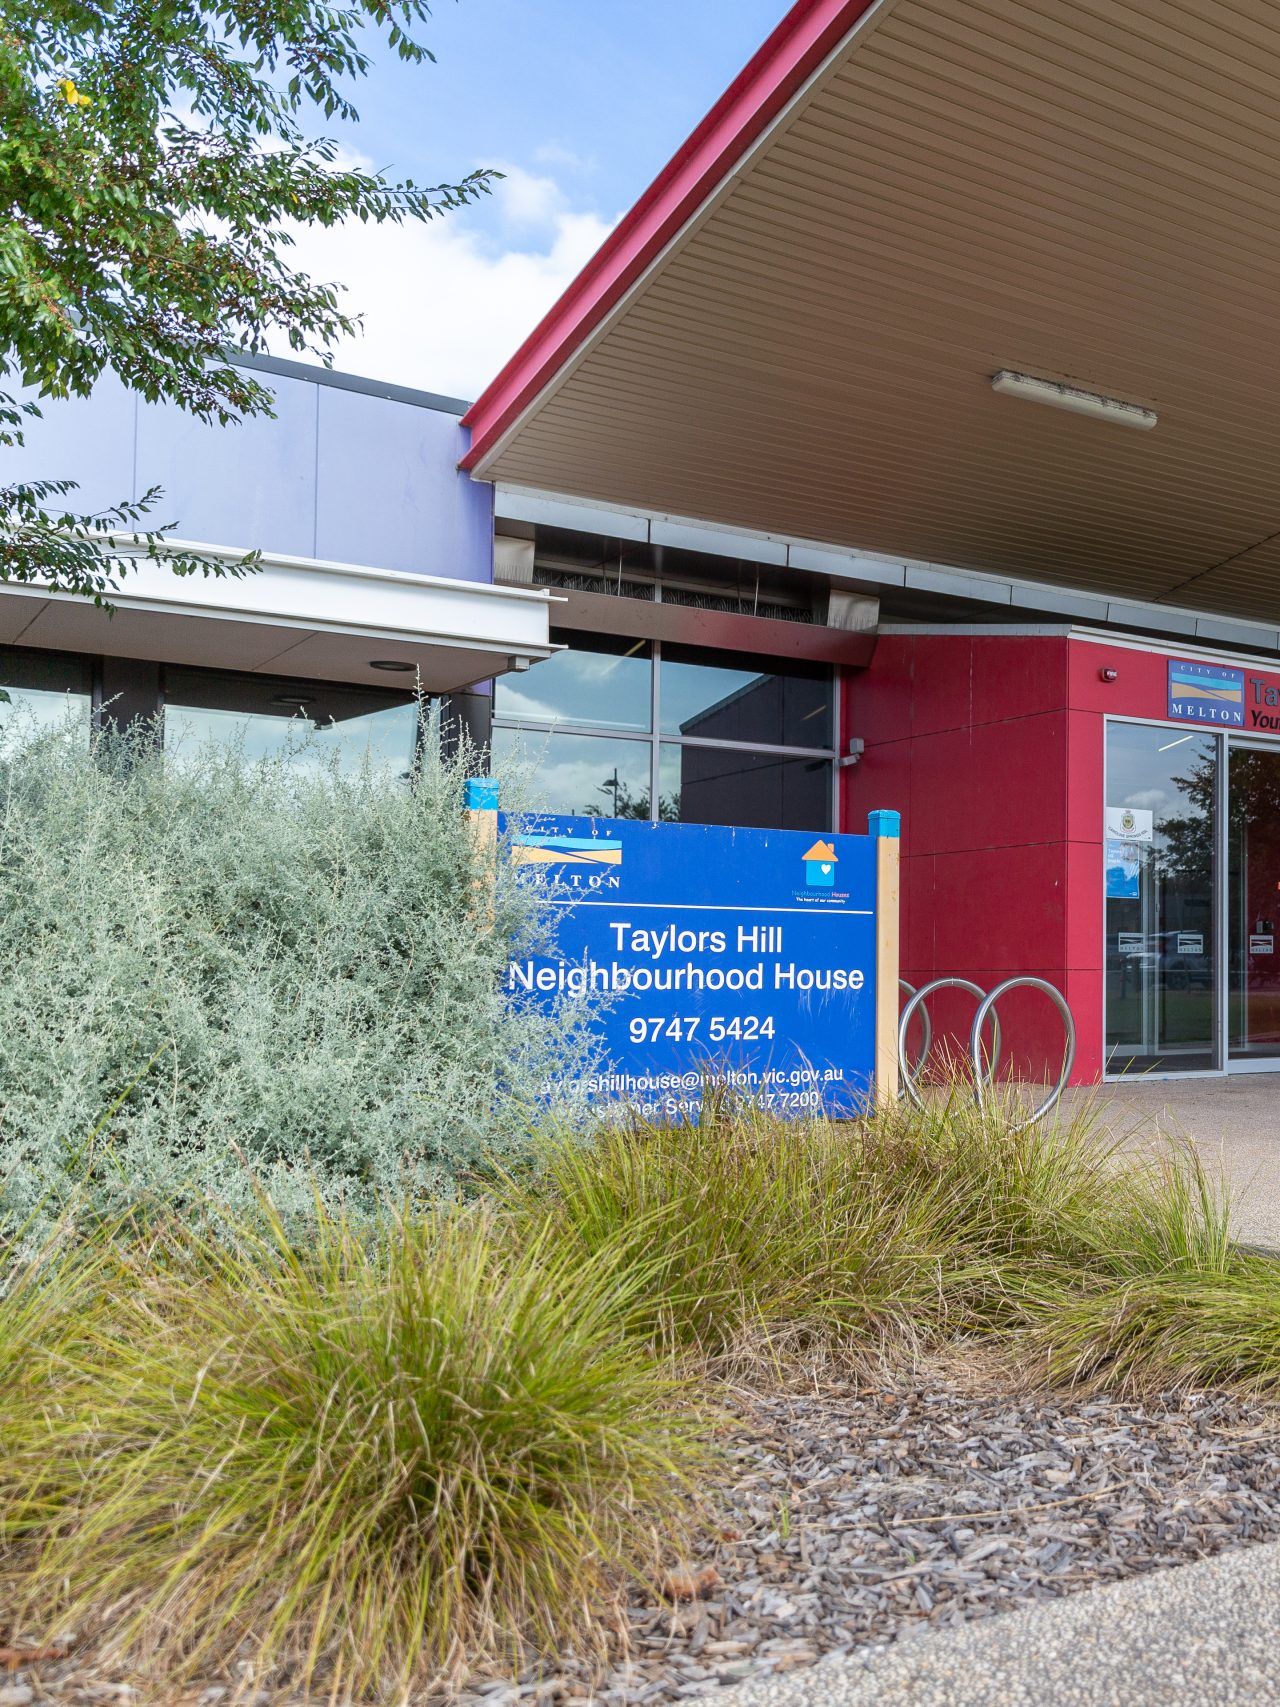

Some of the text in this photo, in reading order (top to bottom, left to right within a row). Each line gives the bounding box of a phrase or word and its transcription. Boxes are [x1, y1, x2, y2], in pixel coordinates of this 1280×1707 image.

[1180, 665, 1236, 679] CITY OF
[1172, 703, 1241, 722] MELTON
[526, 824, 574, 834] CITY
[791, 890, 831, 898] Neighbourhood
[609, 922, 782, 959] Taylors Hill
[509, 960, 864, 998] Neighbourhood House
[629, 1016, 775, 1044] 9747 5424
[780, 1091, 818, 1108] 7200
